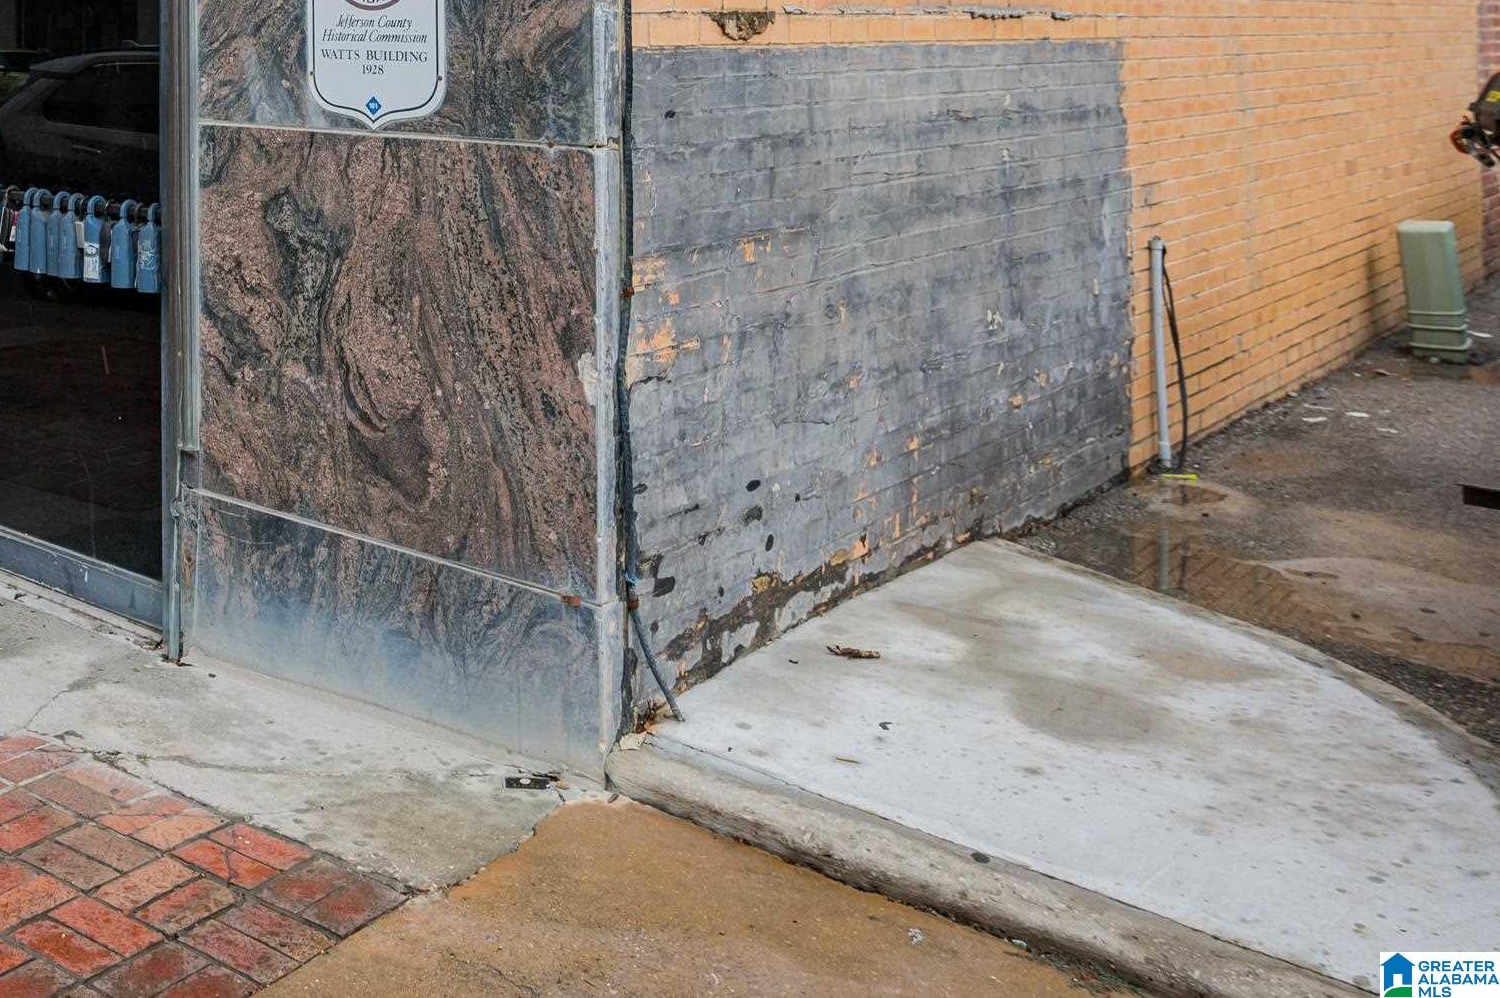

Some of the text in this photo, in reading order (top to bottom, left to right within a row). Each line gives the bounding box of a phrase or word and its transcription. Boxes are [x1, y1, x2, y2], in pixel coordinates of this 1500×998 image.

[336, 14, 412, 31] Jefferson County
[322, 29, 428, 43] Historical Commission
[320, 48, 428, 62] WATTS BUILDING
[362, 64, 385, 75] 1928
